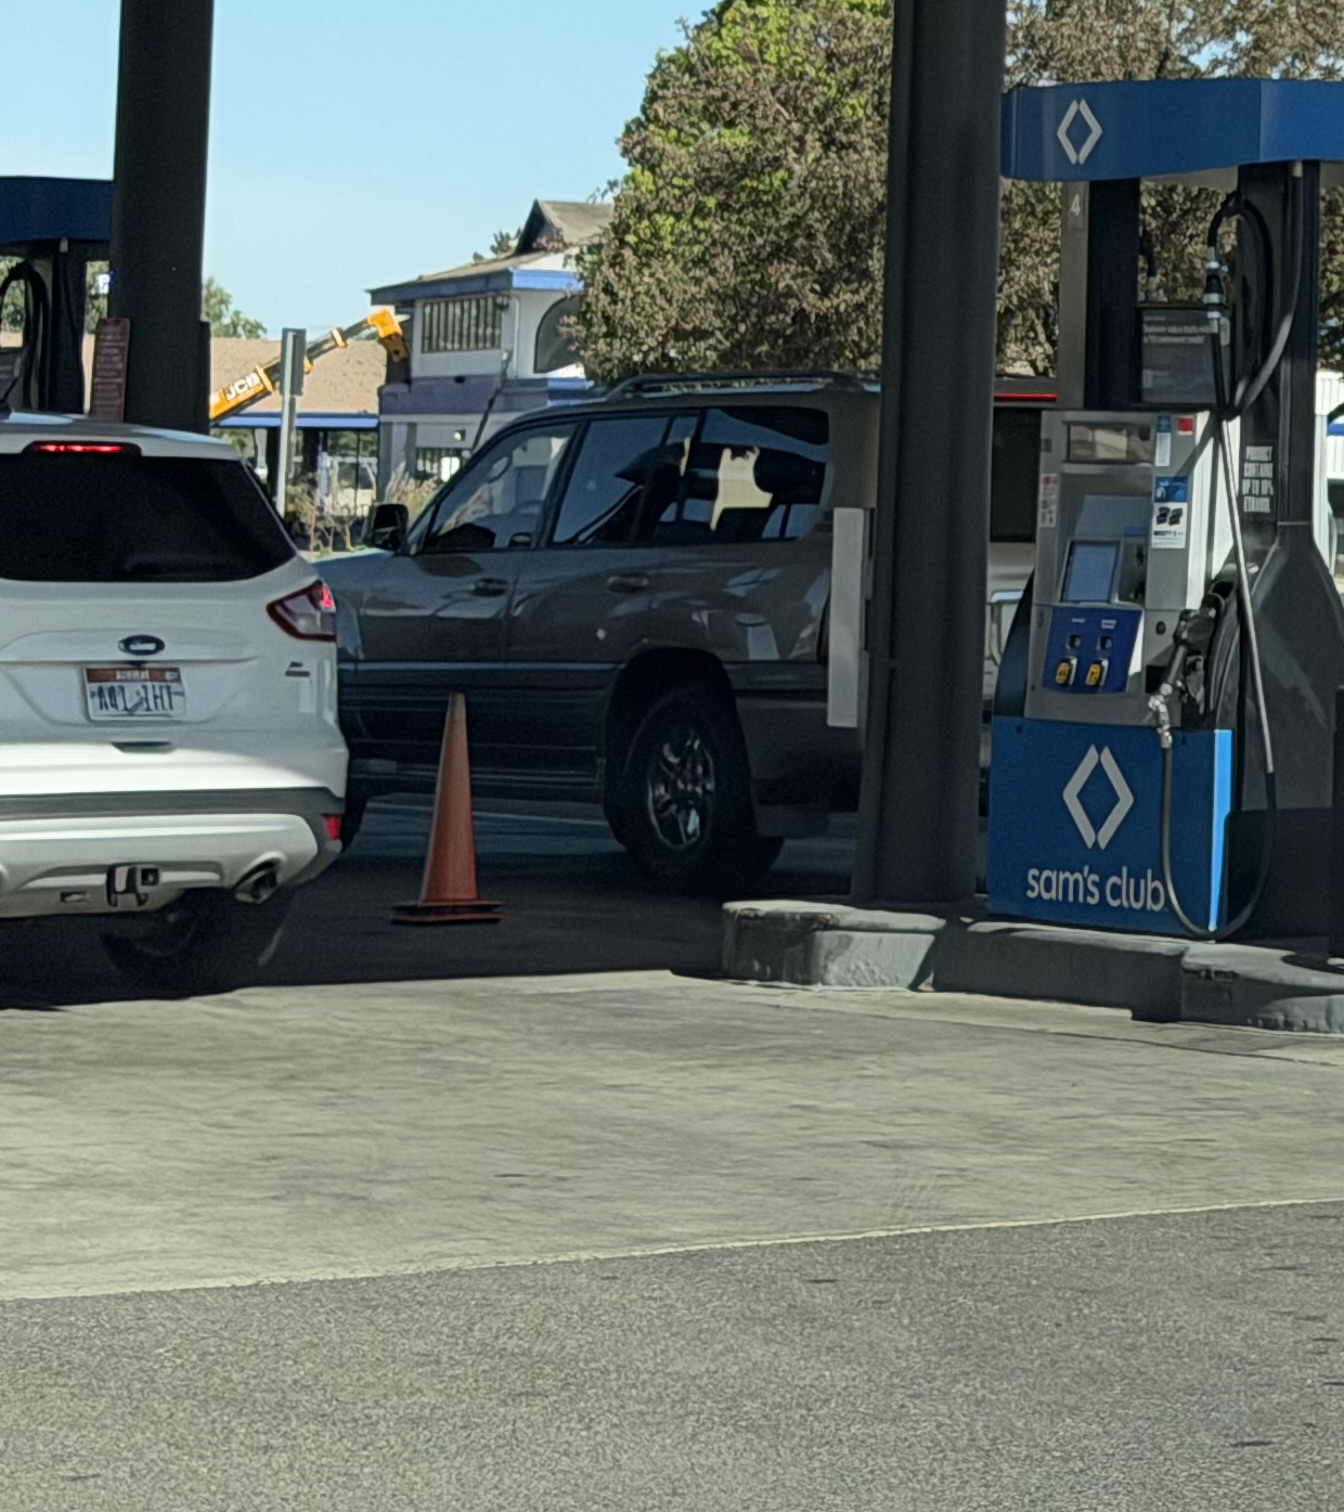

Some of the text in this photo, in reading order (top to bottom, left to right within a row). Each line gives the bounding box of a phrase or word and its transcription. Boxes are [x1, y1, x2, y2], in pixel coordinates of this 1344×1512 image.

[1070, 193, 1081, 216] 4
[1026, 865, 1166, 912] sam's club
